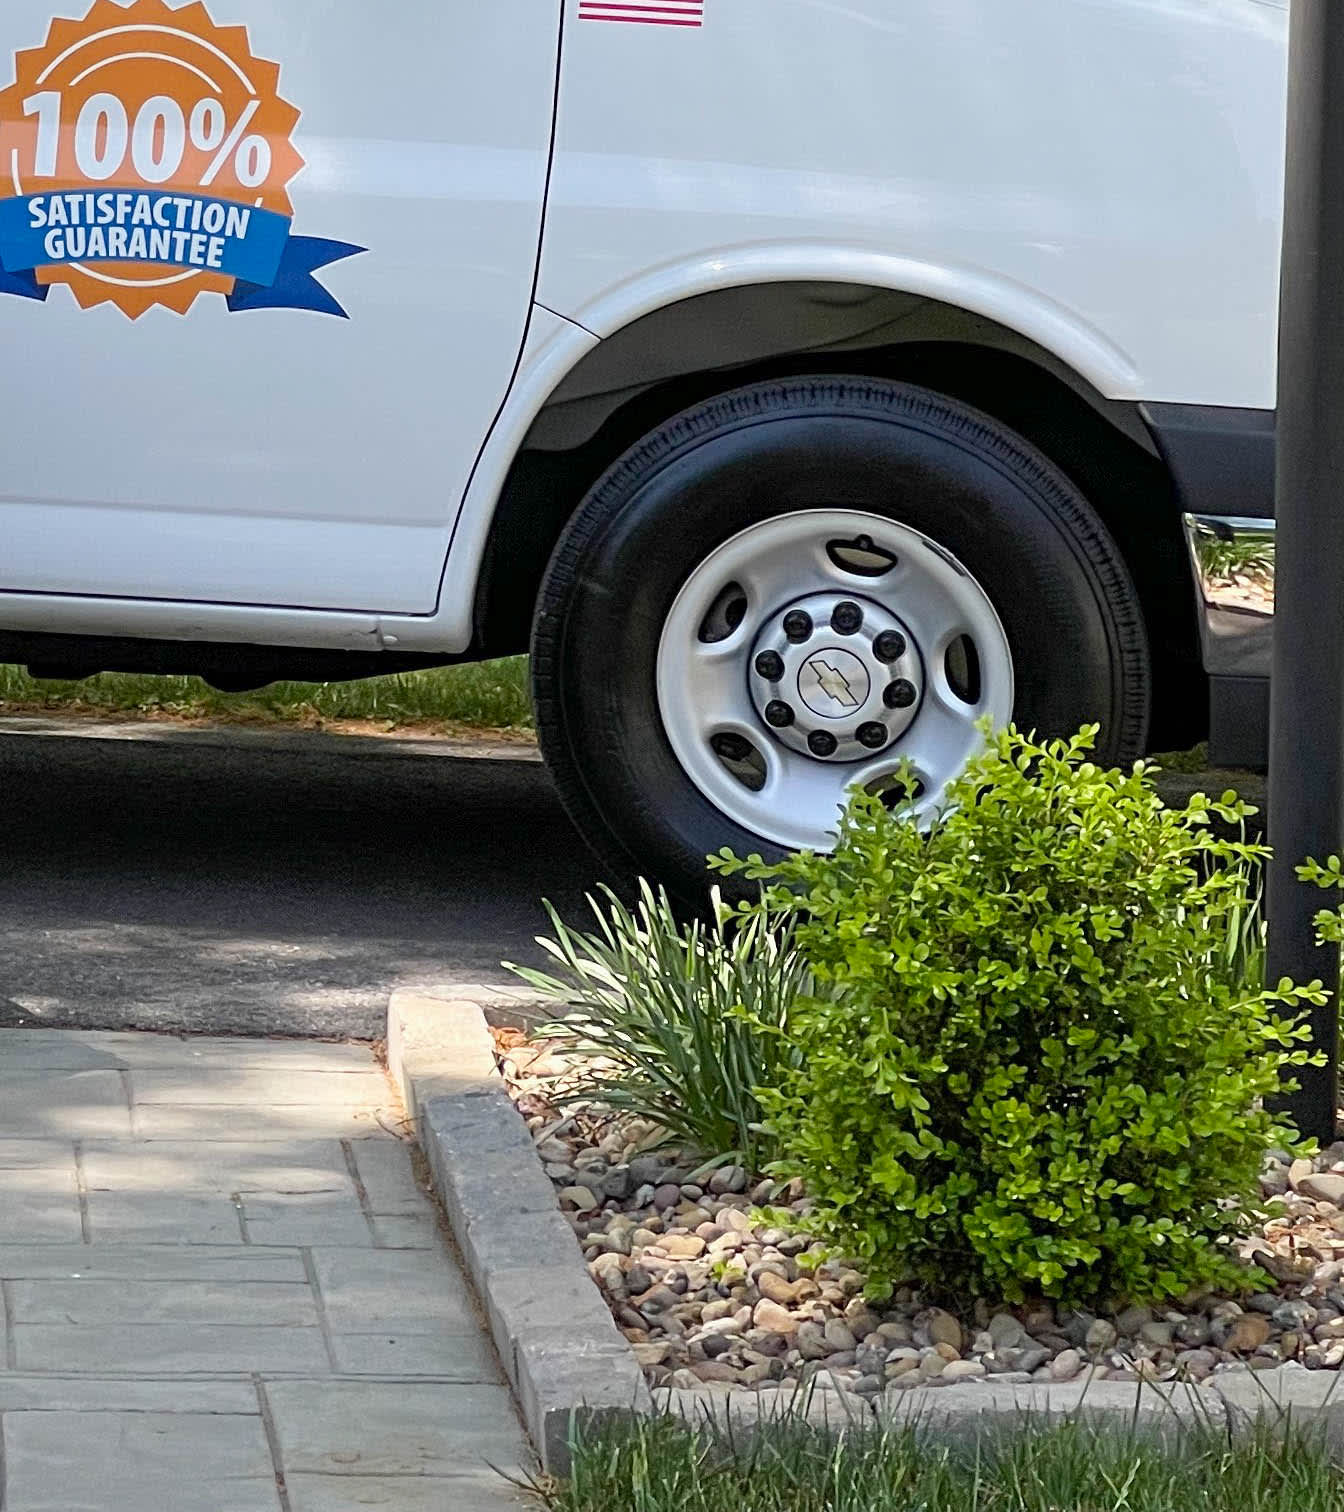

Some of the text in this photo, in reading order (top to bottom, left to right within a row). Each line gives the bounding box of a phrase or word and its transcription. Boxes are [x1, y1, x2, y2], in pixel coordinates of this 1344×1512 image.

[22, 90, 272, 188] 100%
[28, 193, 251, 240] SATISFACTION
[44, 226, 226, 268] GUARANTEE
